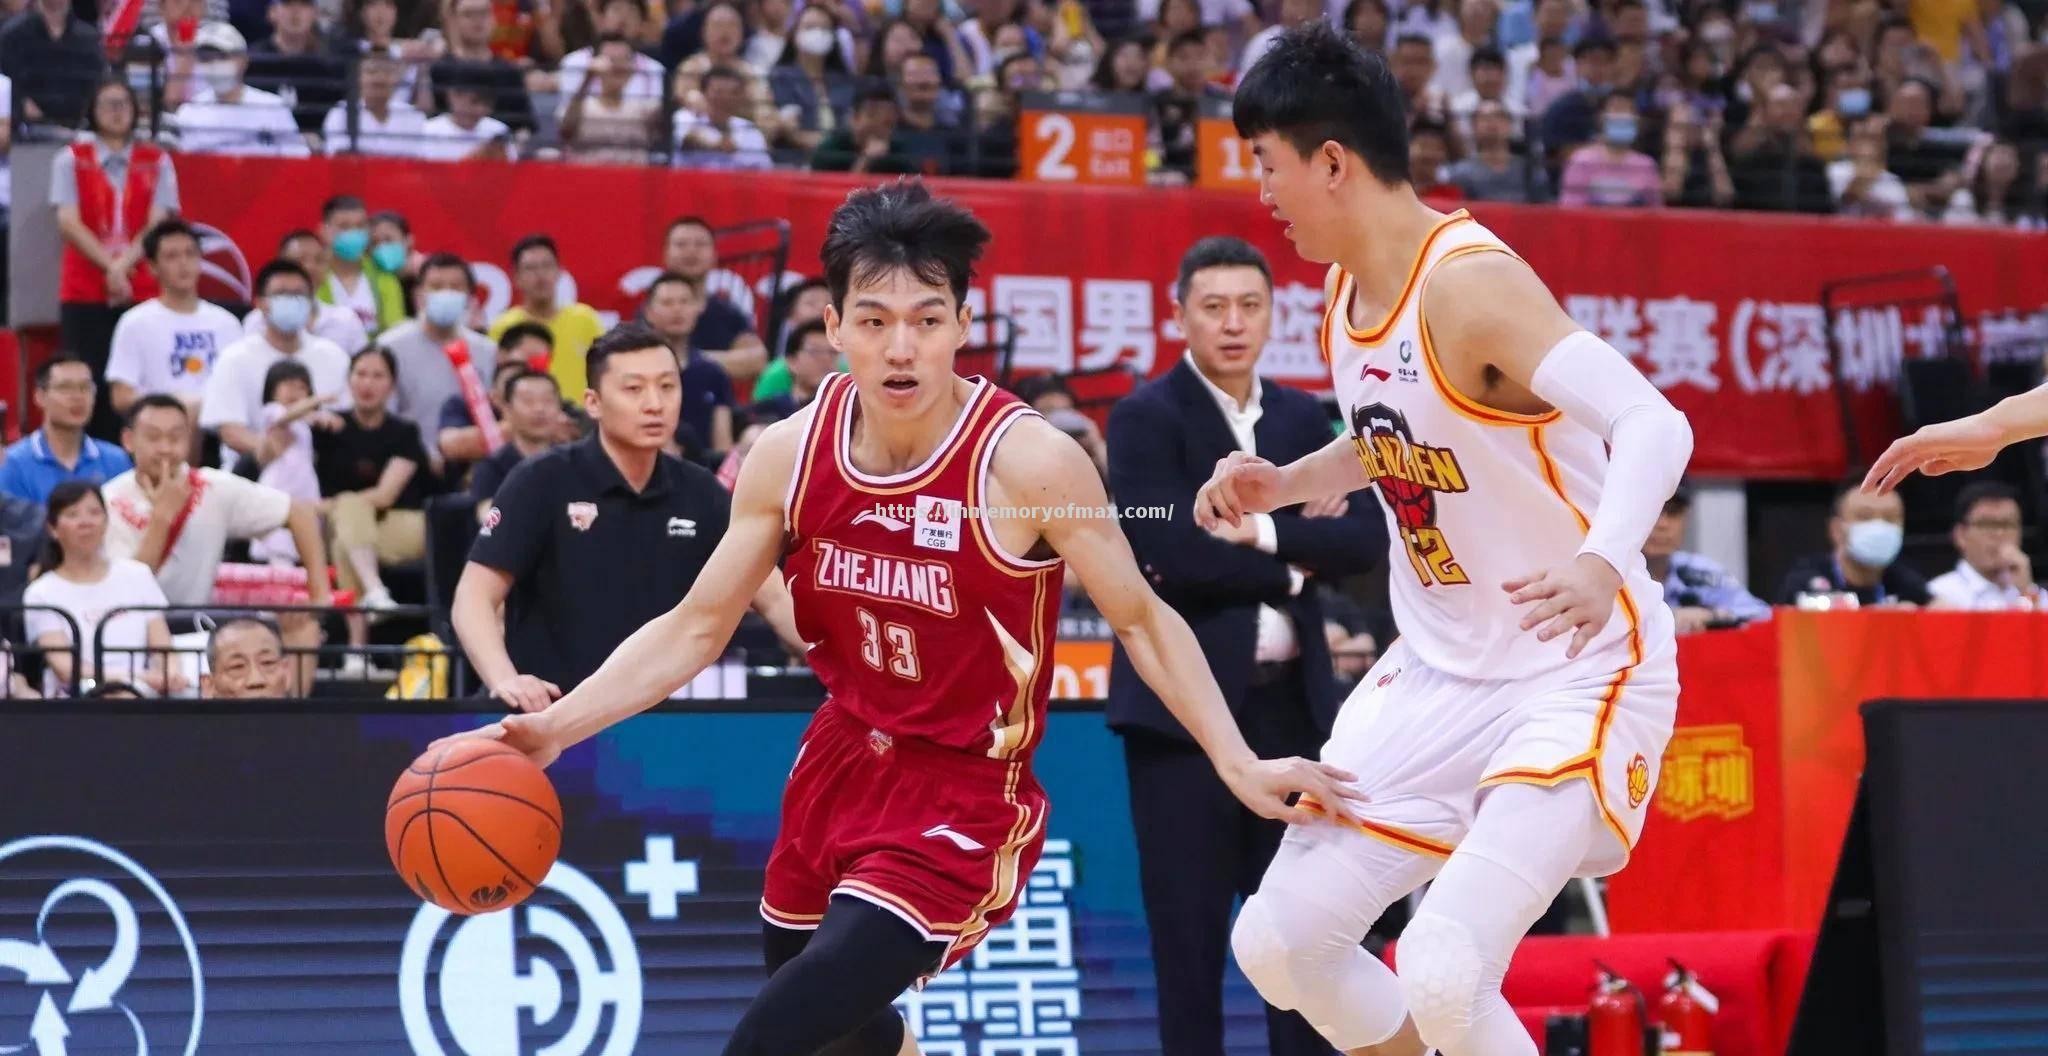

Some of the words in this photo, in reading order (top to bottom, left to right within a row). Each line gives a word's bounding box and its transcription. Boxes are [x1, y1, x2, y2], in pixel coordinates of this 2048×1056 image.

[1036, 113, 1078, 180] 2
[1352, 436, 1469, 492] HENZHEN
[926, 538, 946, 548] CGB
[1400, 525, 1471, 587] 12
[815, 540, 956, 616] ZHEJIANG
[857, 607, 921, 681] 33
